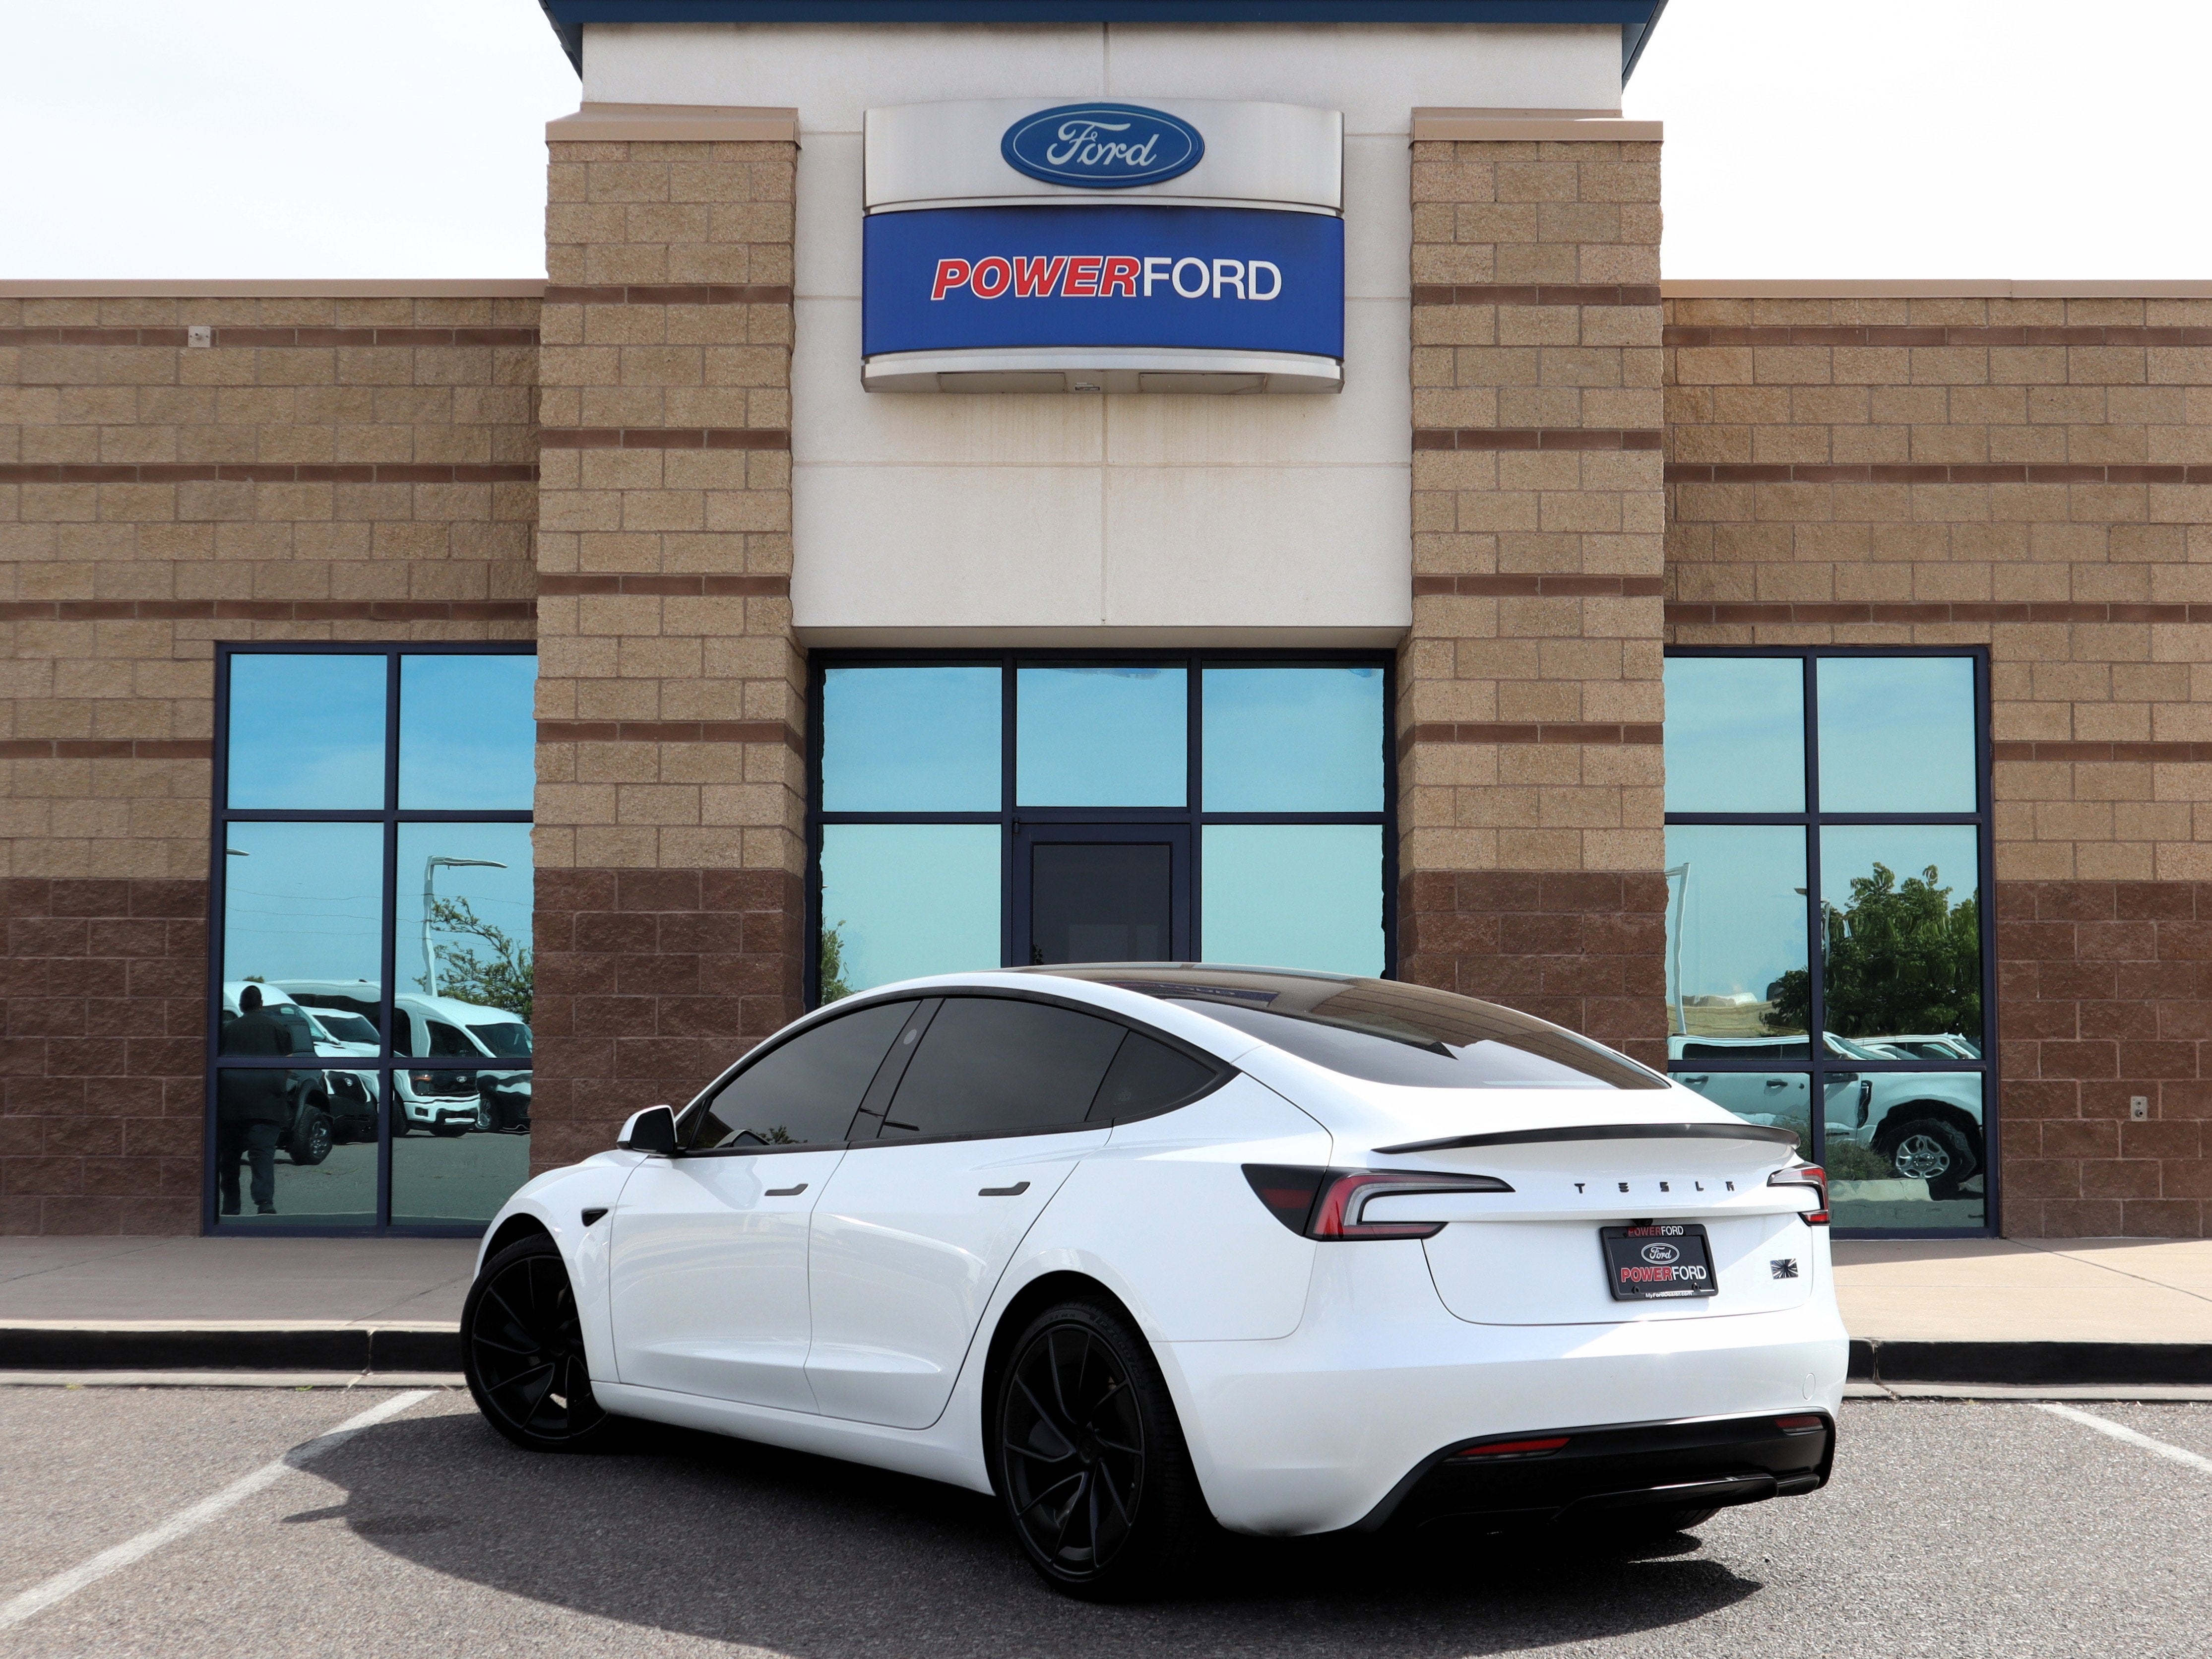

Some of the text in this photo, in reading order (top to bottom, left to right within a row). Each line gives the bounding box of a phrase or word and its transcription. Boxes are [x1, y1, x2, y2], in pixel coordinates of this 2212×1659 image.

[1046, 120, 1160, 166] Ford
[930, 255, 1282, 301] POWERFORD
[1574, 1181, 1735, 1194] TESLA
[1649, 1246, 1672, 1259] Ford
[1621, 1266, 1706, 1282] POWERFORD
